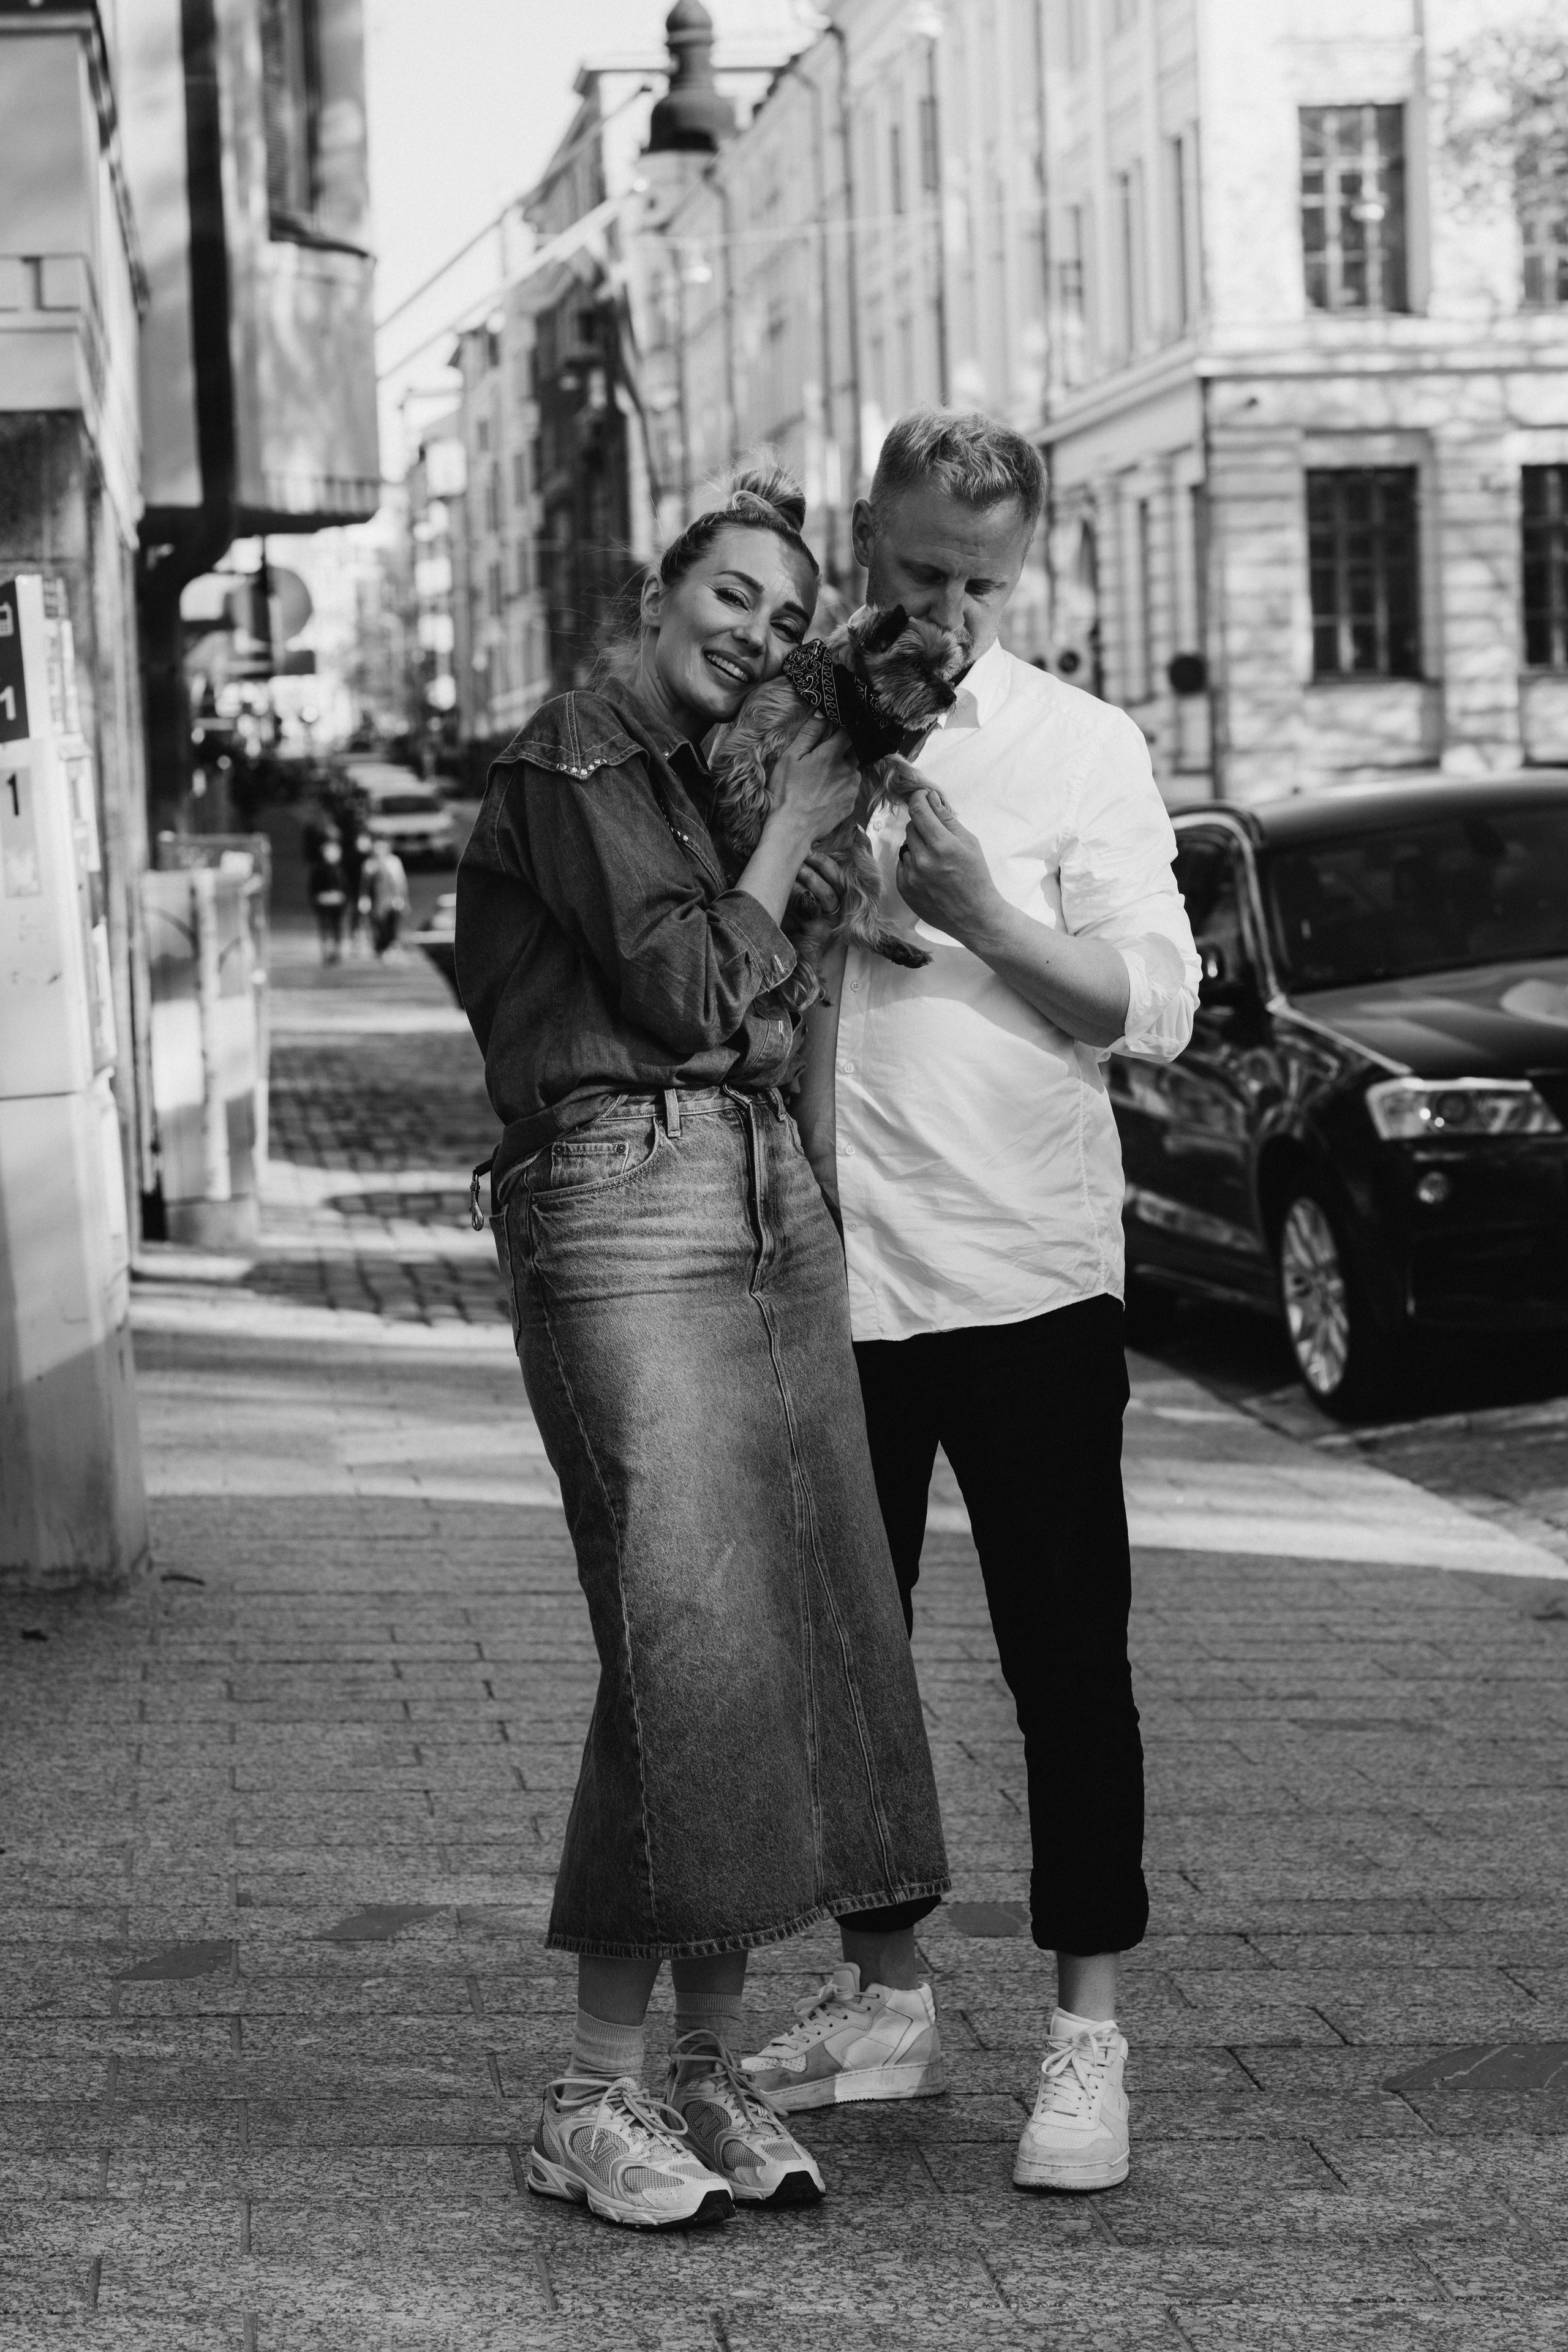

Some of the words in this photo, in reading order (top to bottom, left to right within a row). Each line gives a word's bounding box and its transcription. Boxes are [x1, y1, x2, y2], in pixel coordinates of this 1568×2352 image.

[6, 771, 20, 816] 1
[693, 2109, 722, 2139] N
[582, 2133, 616, 2163] N
